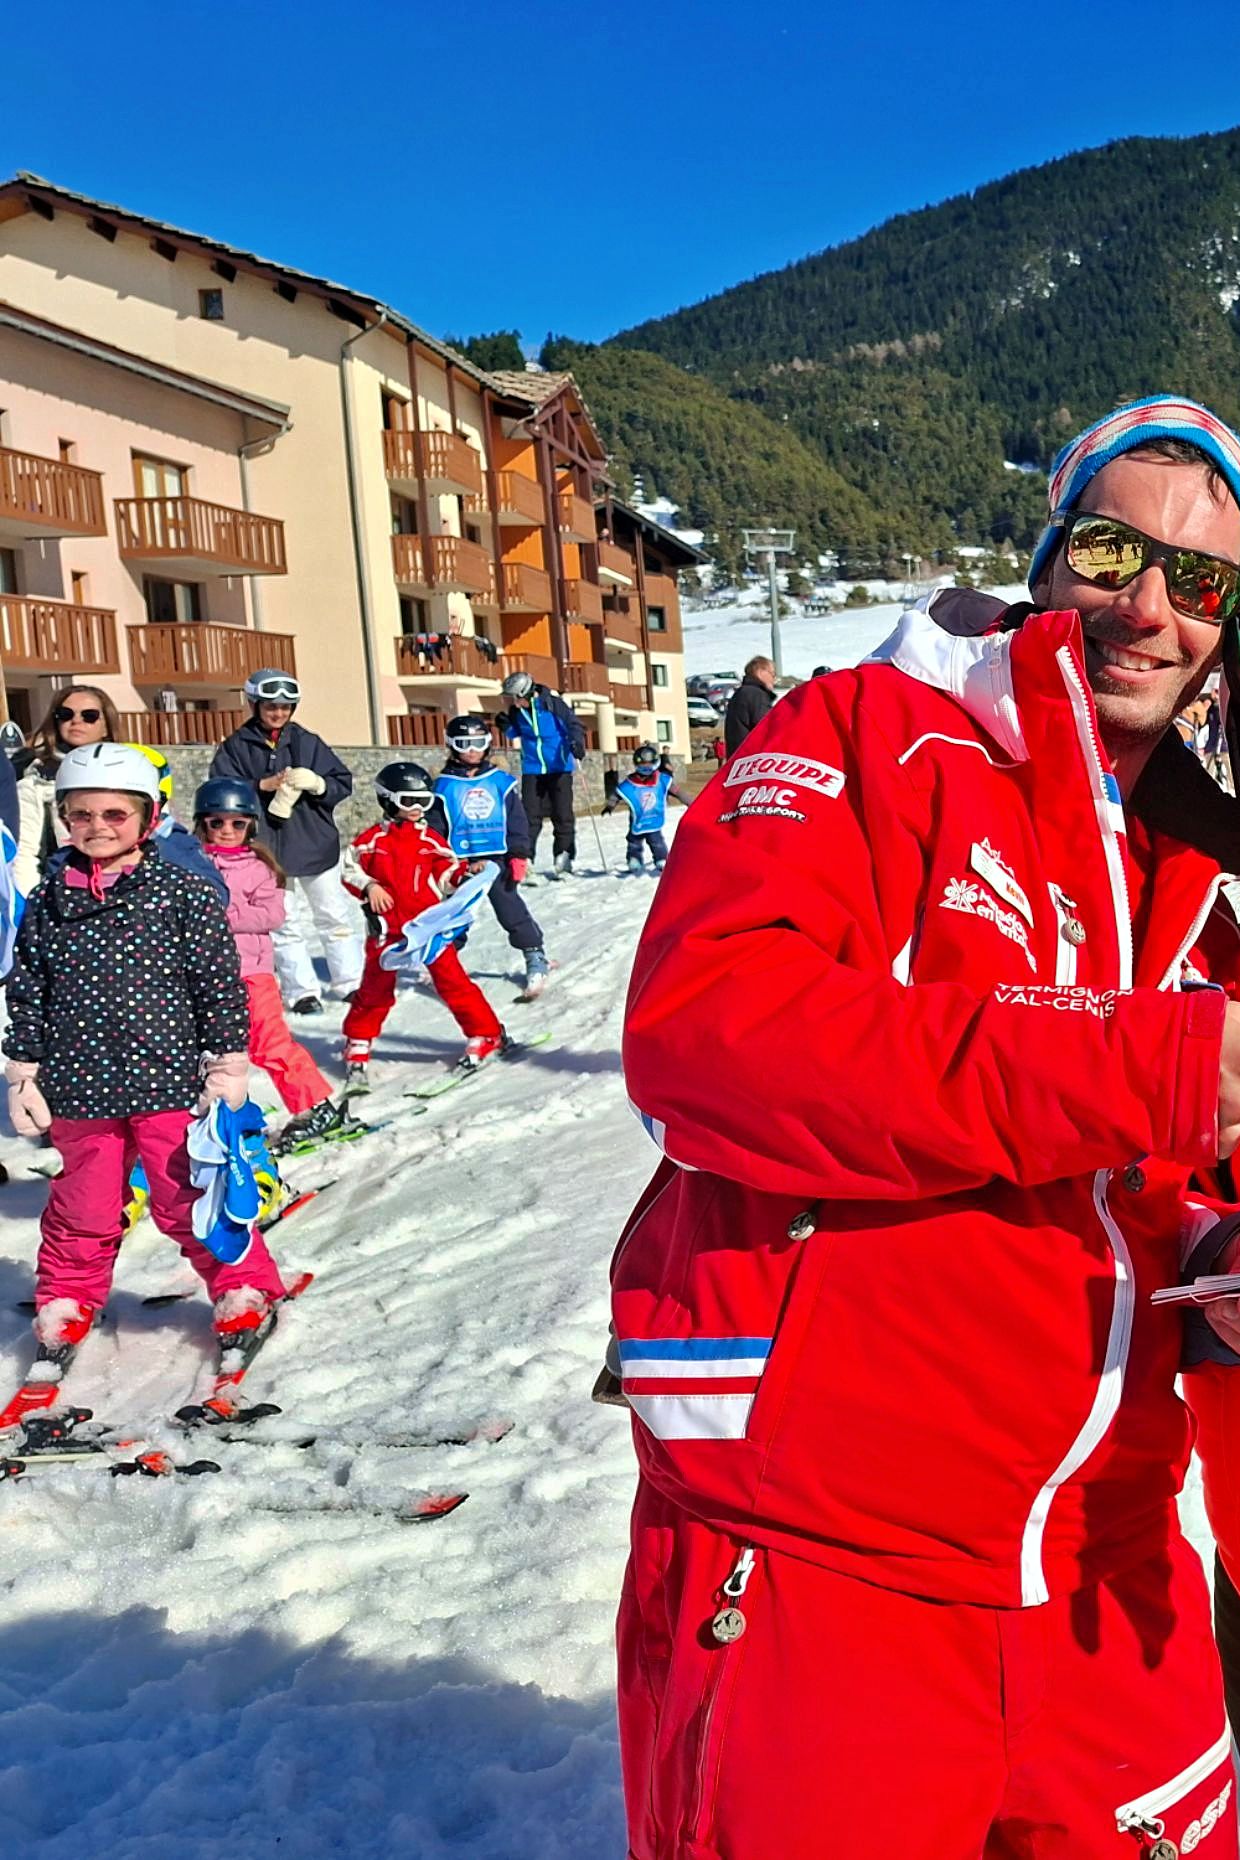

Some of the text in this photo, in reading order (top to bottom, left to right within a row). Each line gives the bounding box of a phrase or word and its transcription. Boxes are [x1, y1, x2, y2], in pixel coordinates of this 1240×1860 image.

[738, 786, 797, 807] RMC
[997, 982, 1135, 1004] TERMIGNON
[994, 990, 1115, 1020] VAL-CENIS
